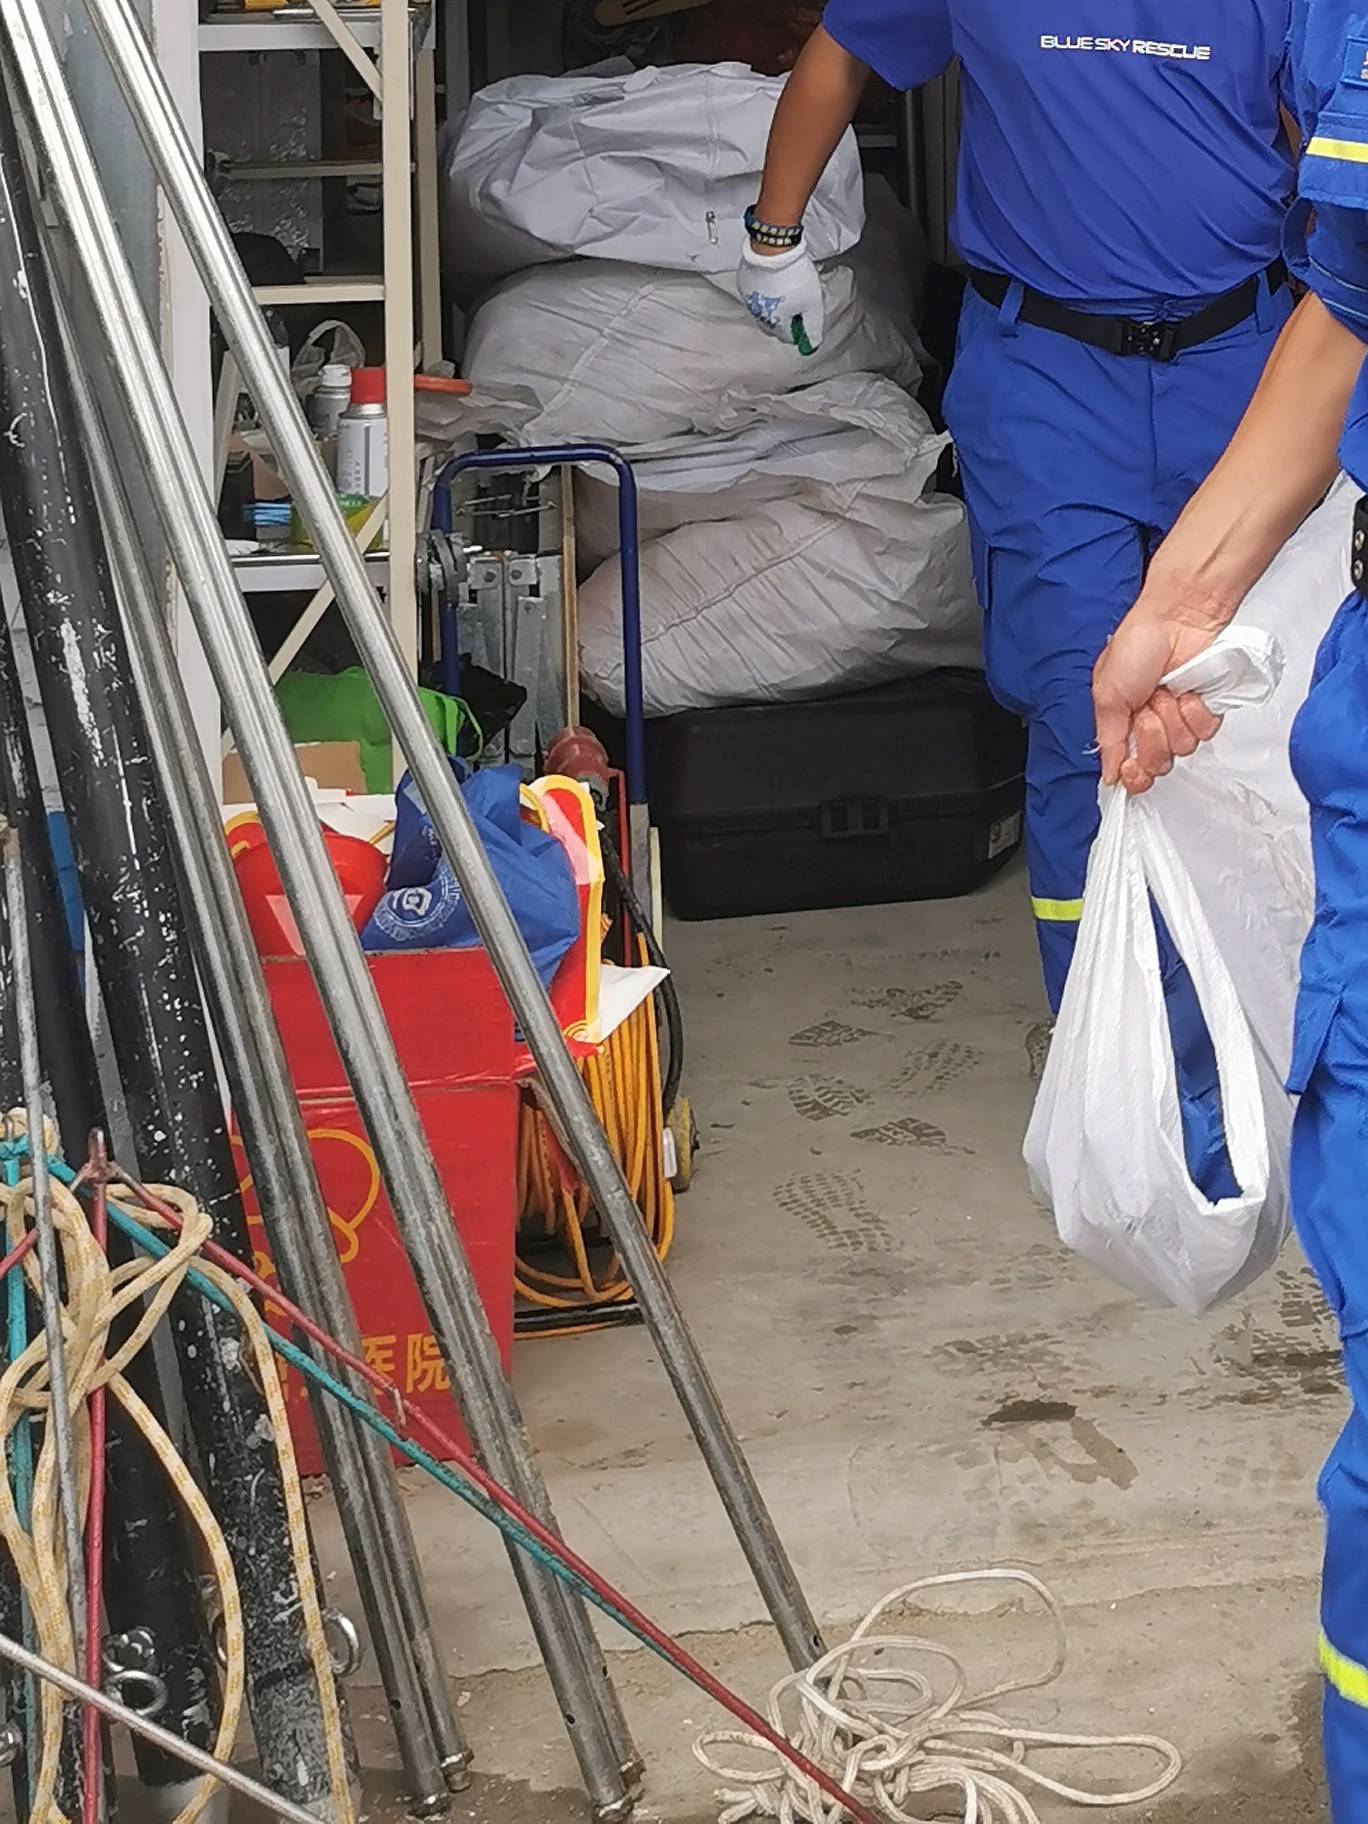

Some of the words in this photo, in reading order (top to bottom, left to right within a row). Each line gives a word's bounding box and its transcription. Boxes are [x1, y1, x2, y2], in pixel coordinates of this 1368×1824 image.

[1040, 35, 1093, 50] BLUE
[1095, 38, 1130, 52] SKY
[1132, 39, 1212, 60] RESCUE
